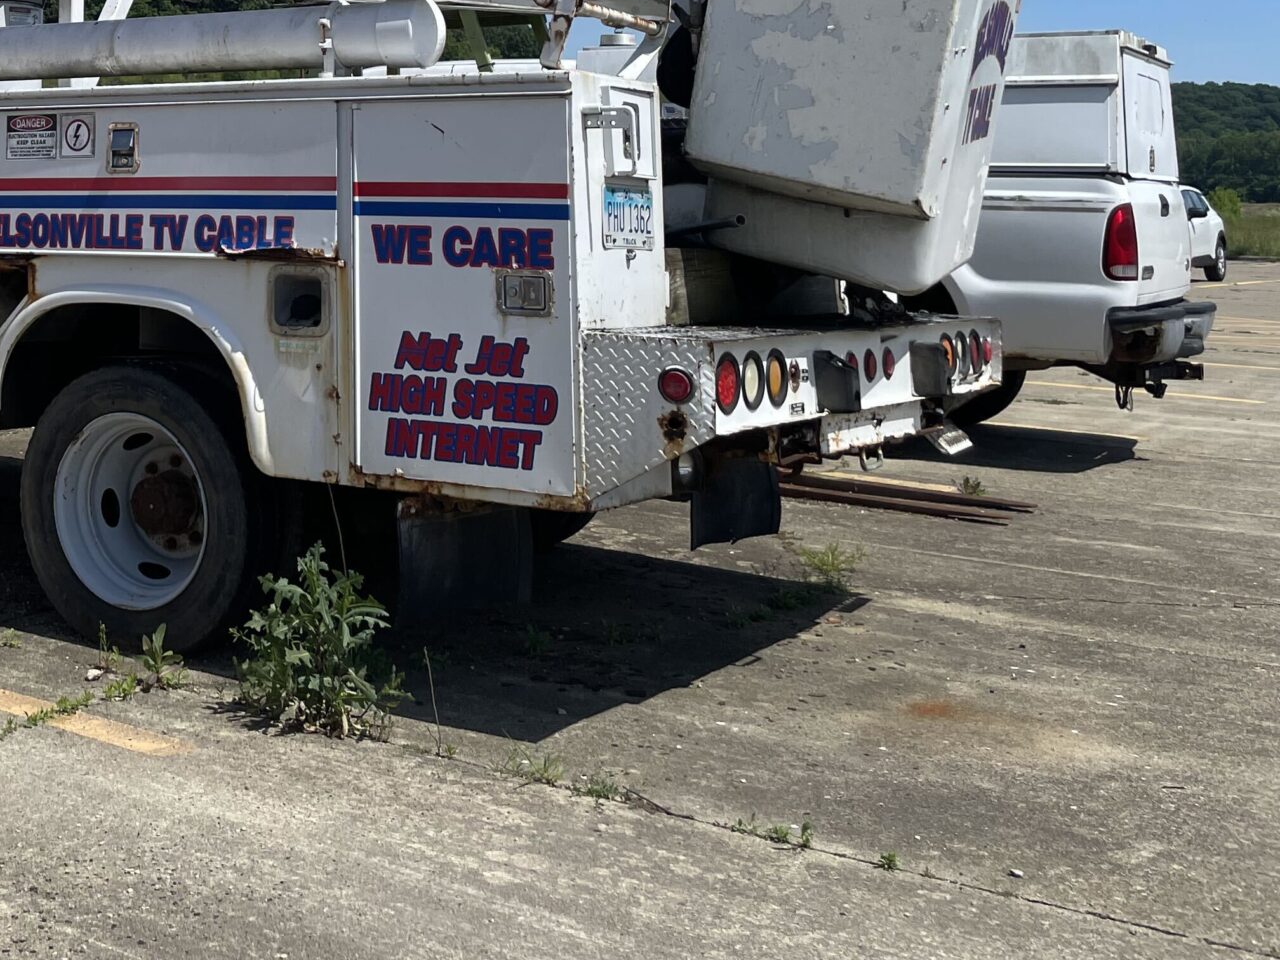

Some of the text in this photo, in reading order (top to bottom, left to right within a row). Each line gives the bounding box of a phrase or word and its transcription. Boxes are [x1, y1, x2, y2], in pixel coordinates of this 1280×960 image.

[16, 118, 46, 128] DANGER
[150, 214, 188, 251] TV
[194, 214, 294, 252] CABLE
[607, 201, 651, 234] PHU 1362
[371, 224, 554, 270] WE CARE
[394, 331, 530, 377] Net Jet
[369, 372, 558, 425] HIGH SPEED
[385, 418, 543, 470] INTERNET
